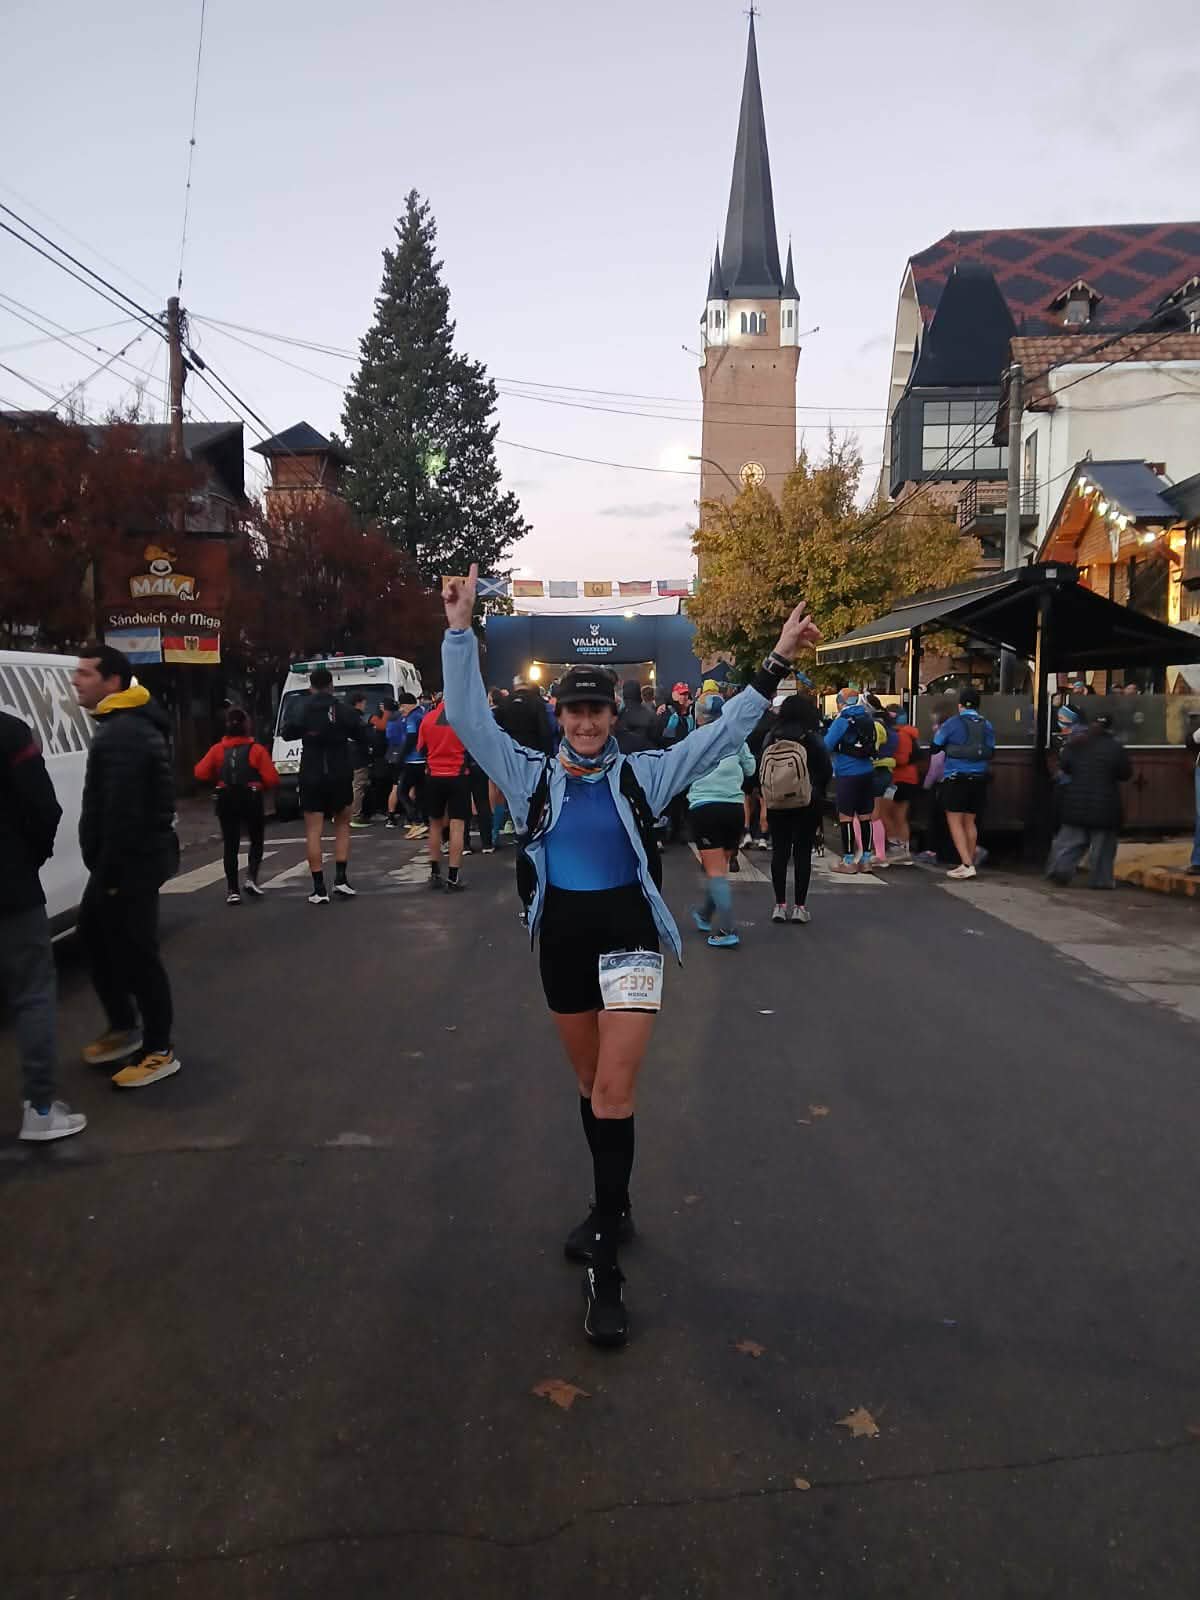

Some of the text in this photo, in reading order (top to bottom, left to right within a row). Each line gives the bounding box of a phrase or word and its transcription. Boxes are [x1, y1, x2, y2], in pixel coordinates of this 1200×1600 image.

[133, 578, 191, 595] MAKA
[170, 612, 186, 624] de
[190, 613, 221, 629] Miga
